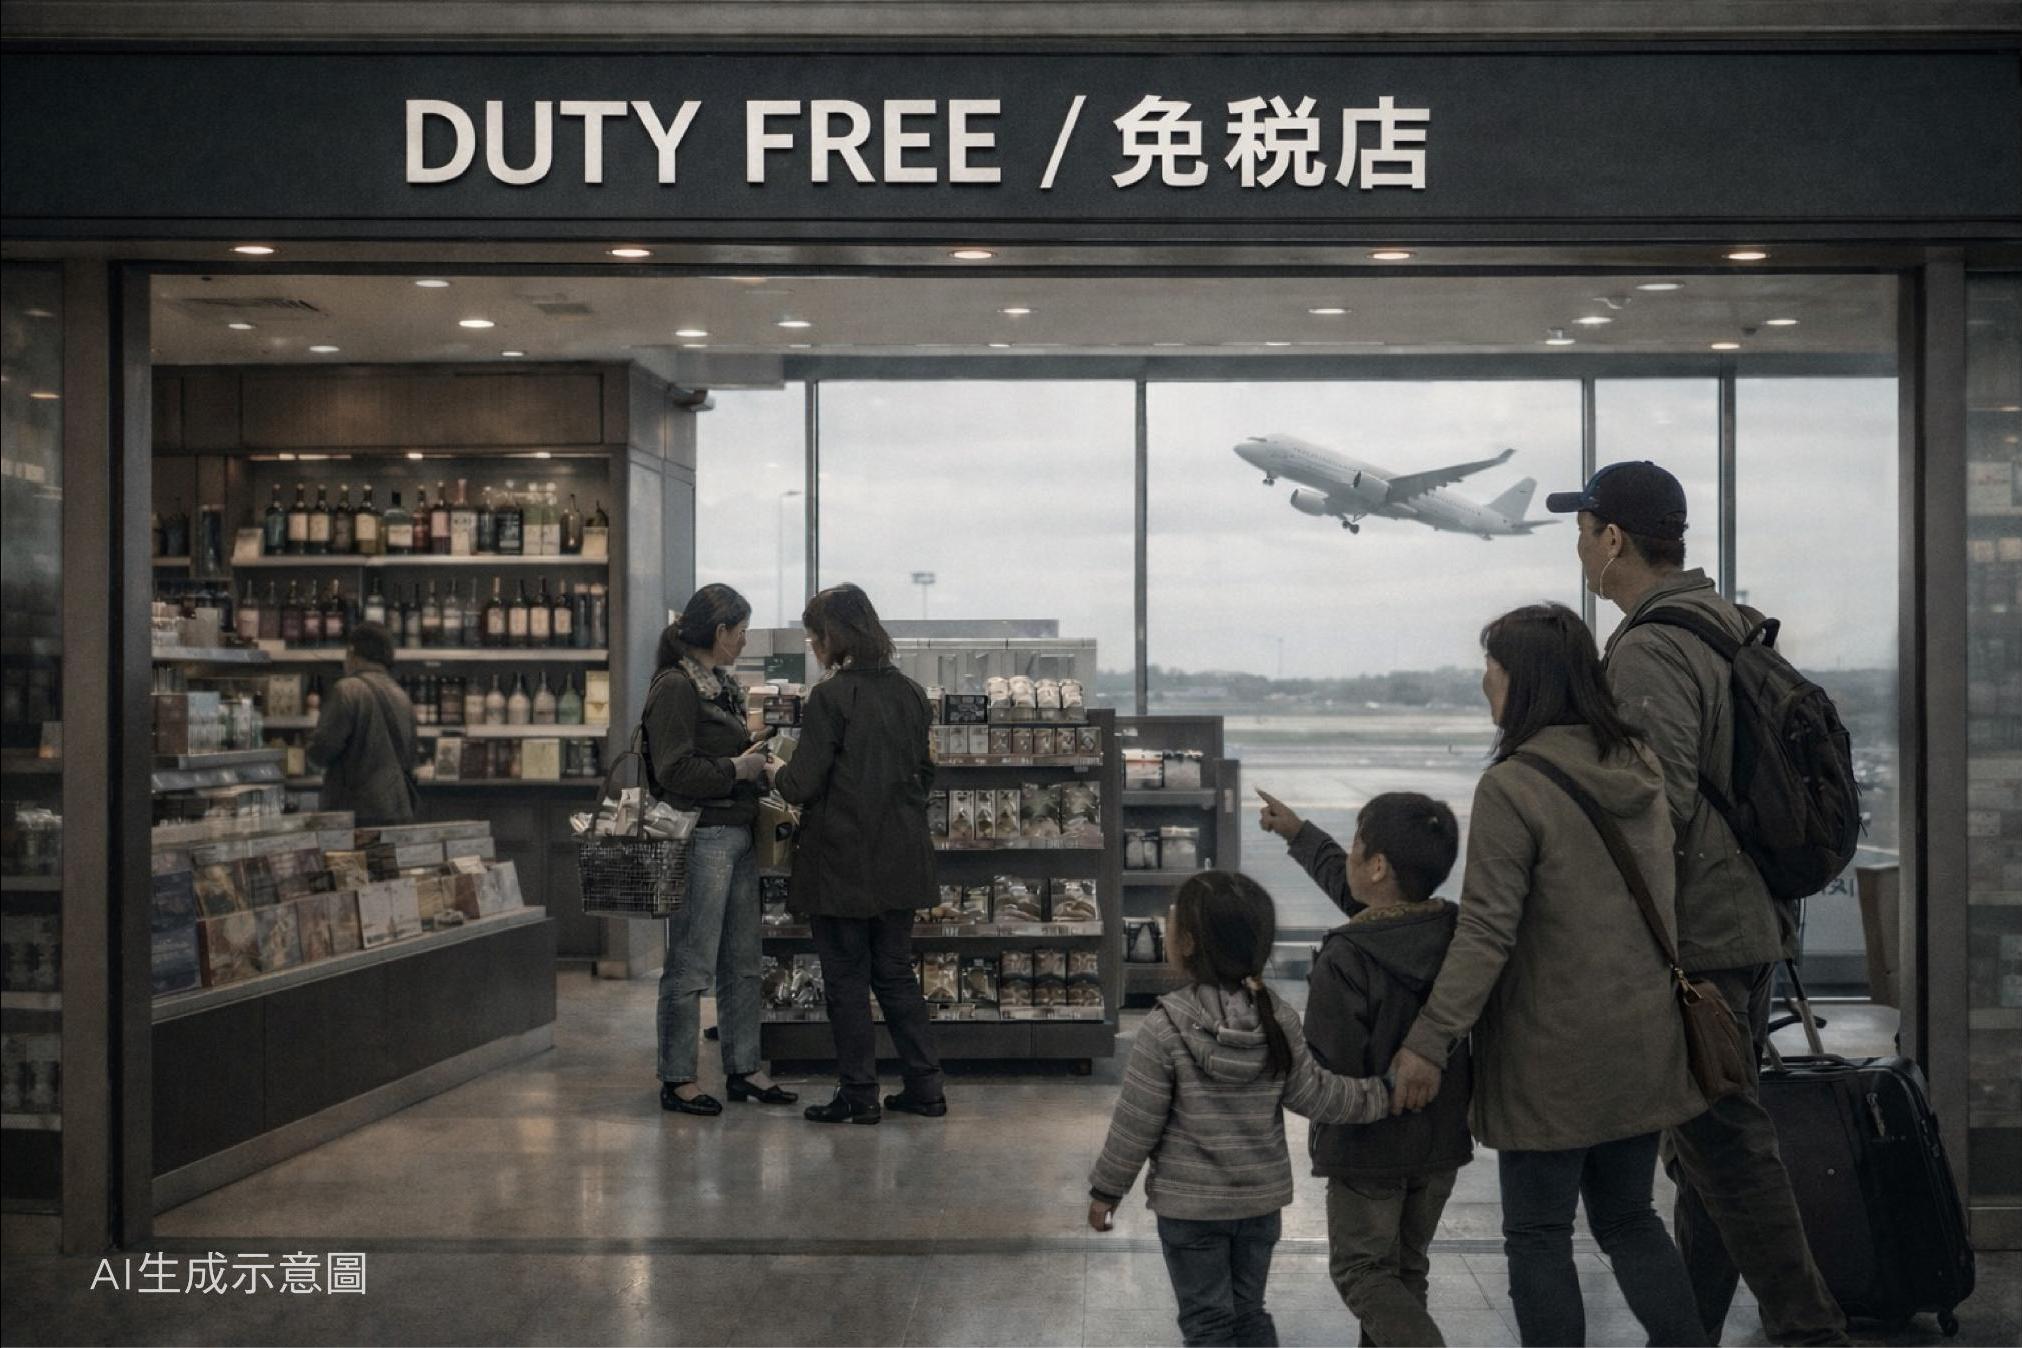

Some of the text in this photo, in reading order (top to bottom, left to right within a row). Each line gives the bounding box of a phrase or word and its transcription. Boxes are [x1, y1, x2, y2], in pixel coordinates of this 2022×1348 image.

[405, 94, 1430, 189] DUTY FREE / 免税店
